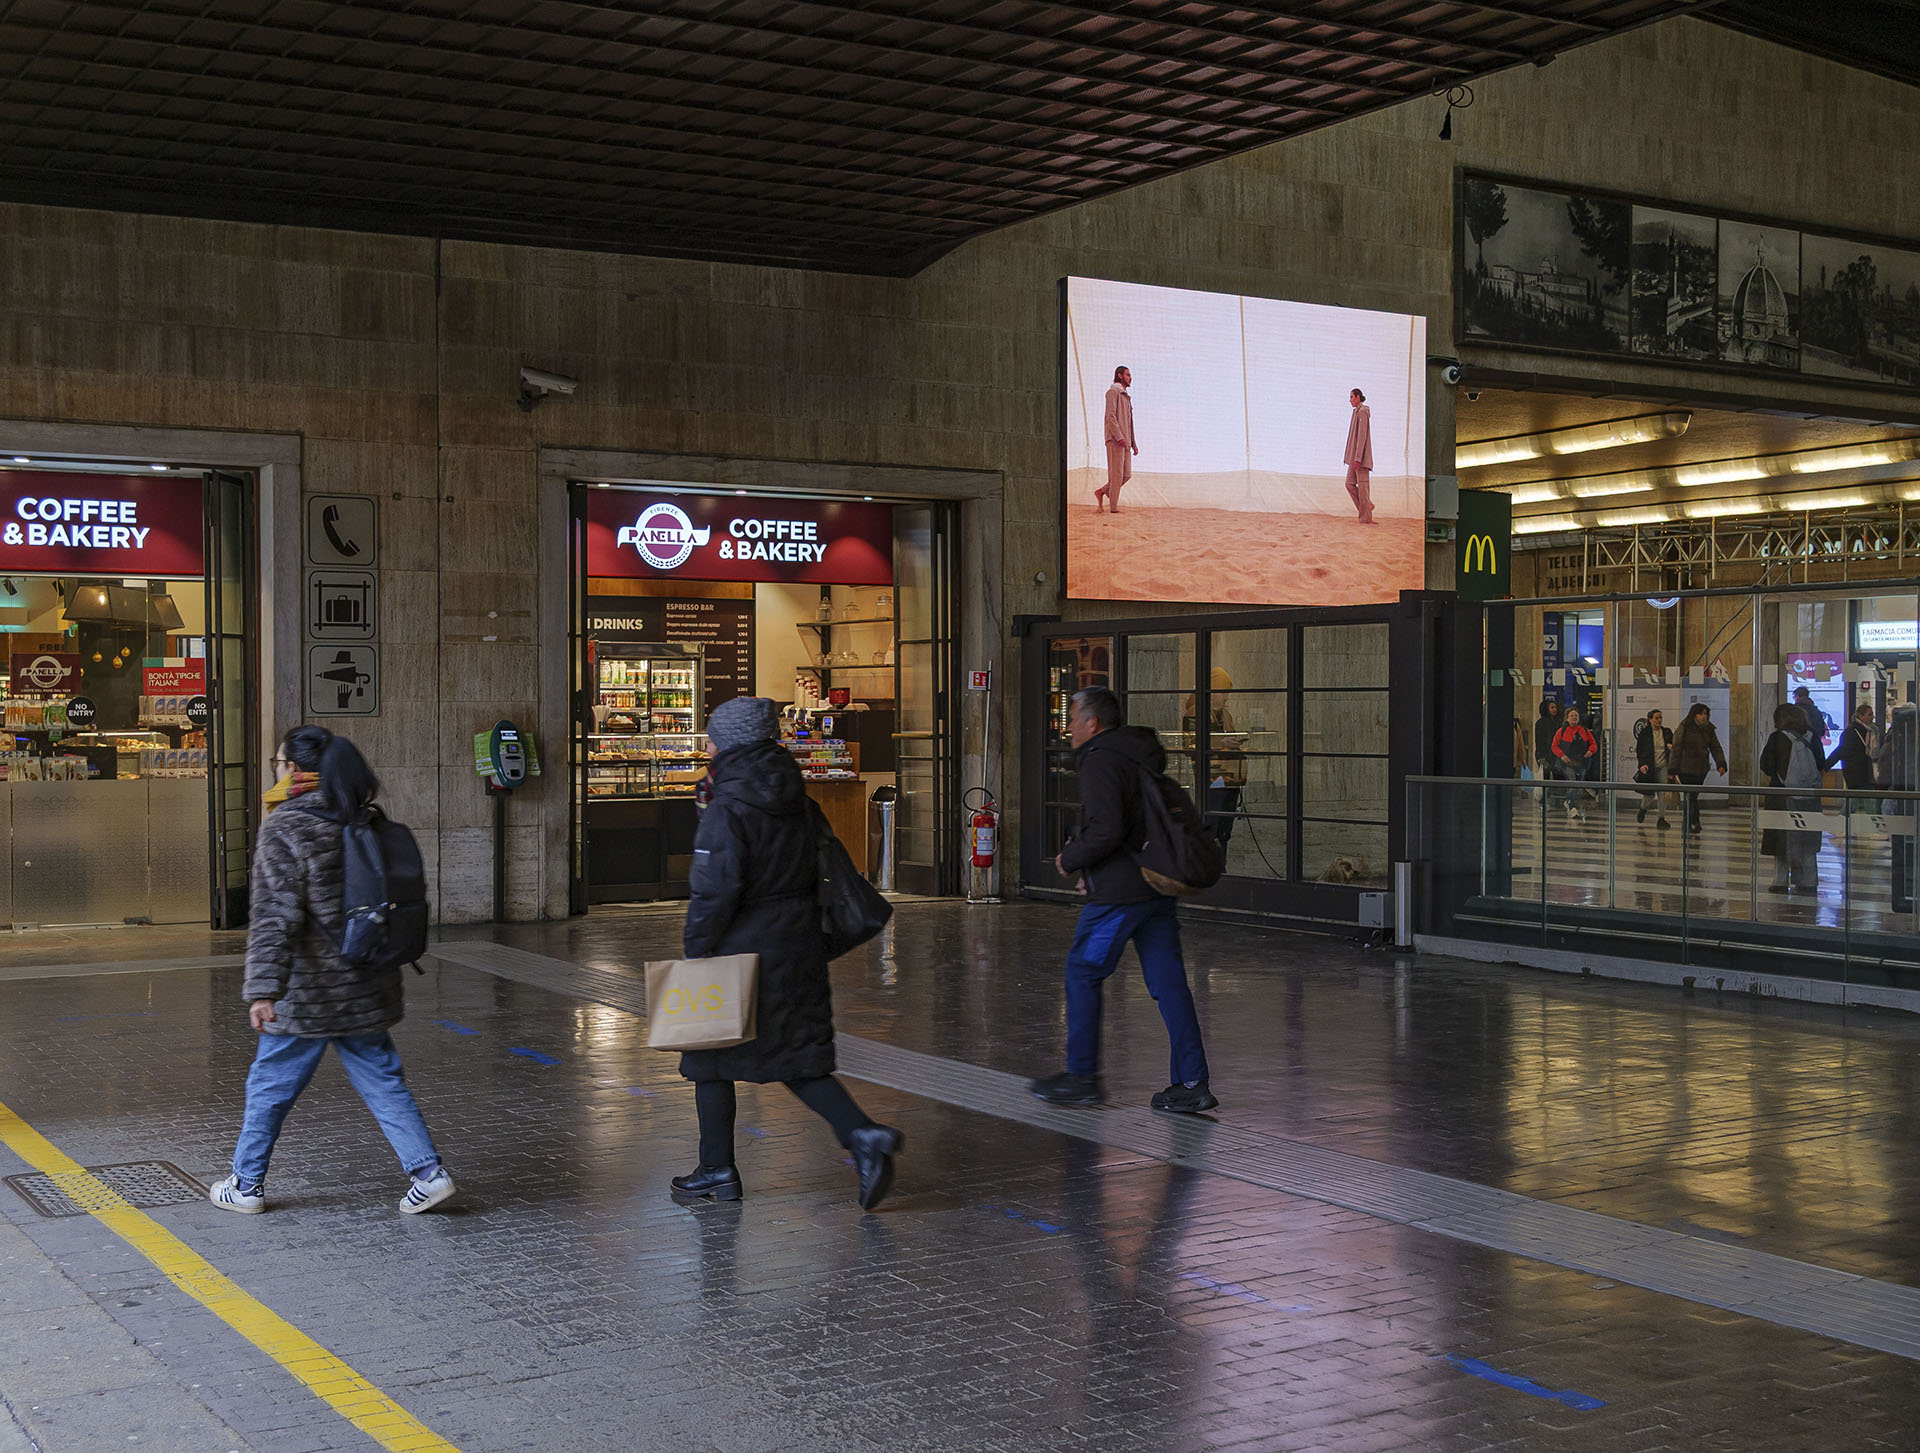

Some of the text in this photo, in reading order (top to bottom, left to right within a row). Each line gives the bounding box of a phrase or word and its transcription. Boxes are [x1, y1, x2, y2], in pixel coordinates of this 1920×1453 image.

[17, 497, 137, 523] COFFEE
[649, 506, 679, 515] FIRENZE
[729, 518, 818, 540] COFFEE
[628, 529, 698, 544] PANELLA
[666, 603, 699, 611] ESPRESSO
[593, 617, 644, 631] DRINKS
[1862, 628, 1896, 636] FARMACIA
[26, 668, 65, 676] PANELLA
[148, 671, 201, 680] BONTÀ TIPICHE
[148, 679, 180, 687] ITALIANE
[68, 709, 94, 717] ENTRY
[663, 984, 724, 1015] OVS
